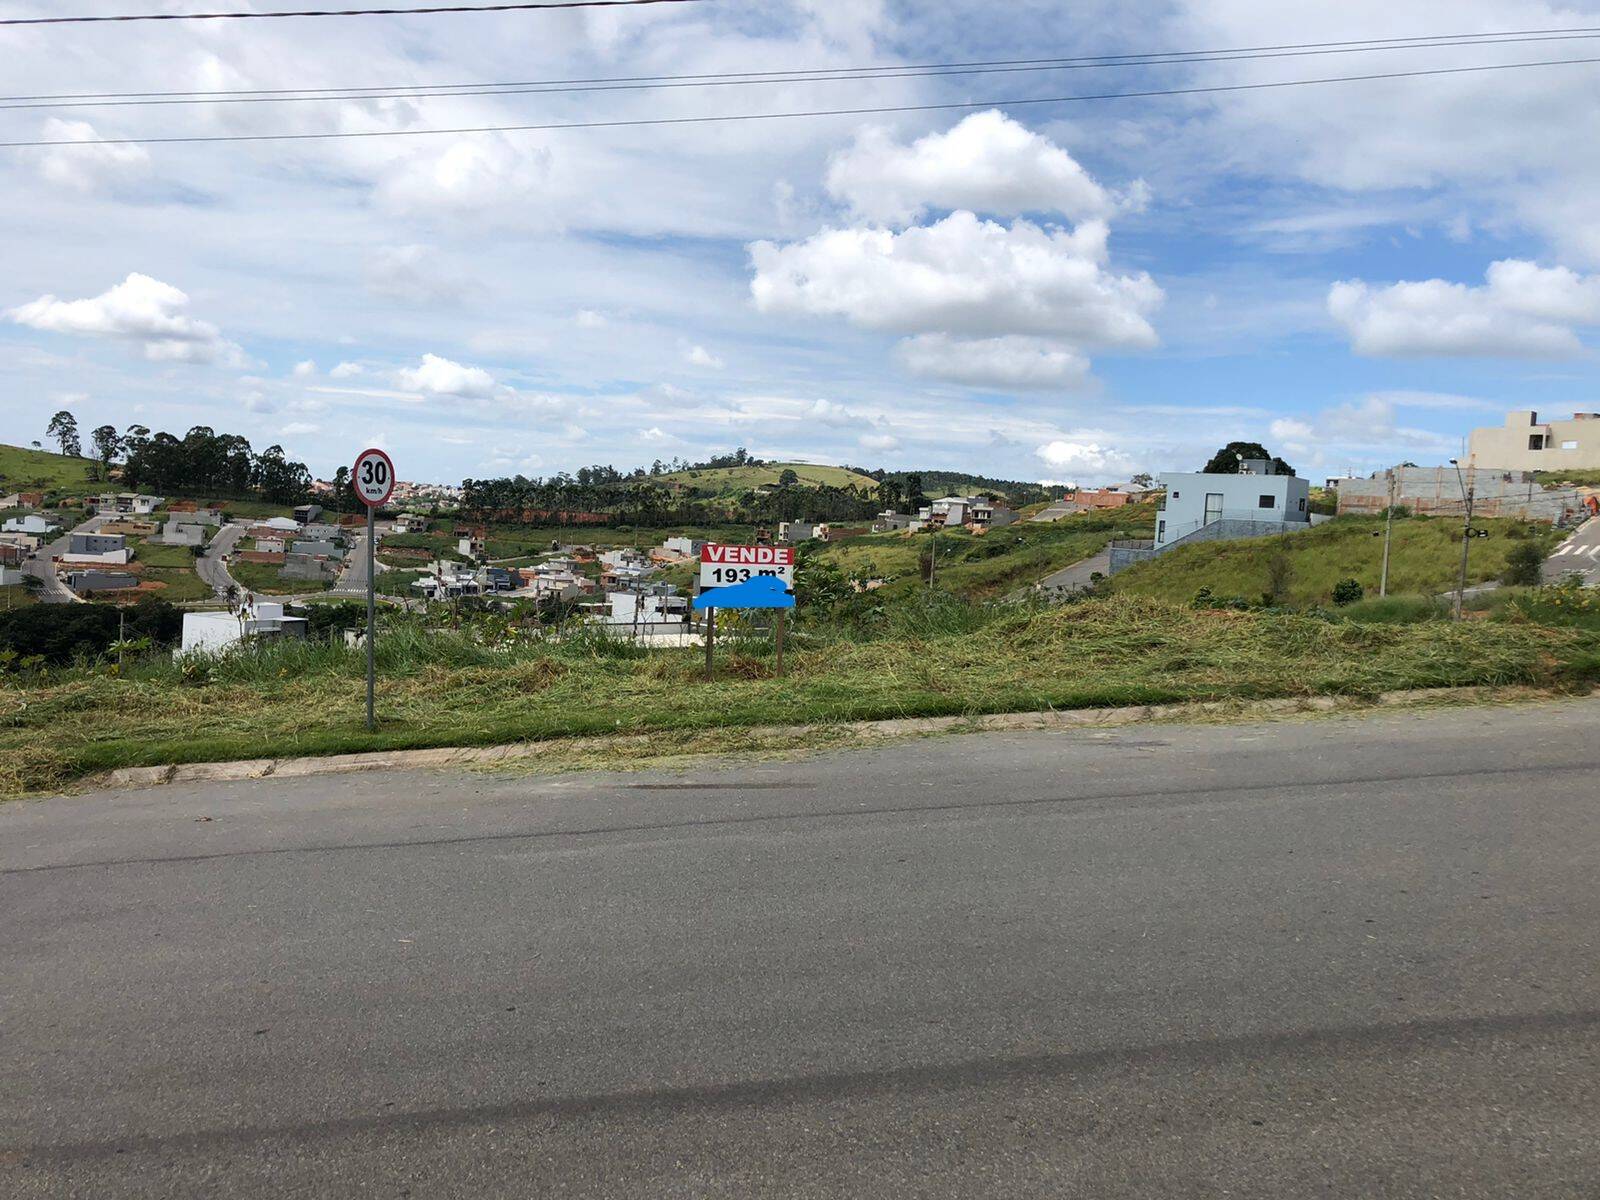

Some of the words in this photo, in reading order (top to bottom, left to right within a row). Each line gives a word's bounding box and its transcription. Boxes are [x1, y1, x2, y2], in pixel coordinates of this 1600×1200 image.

[362, 461, 386, 484] 30
[707, 546, 788, 564] VENDE
[712, 568, 751, 583] 193
